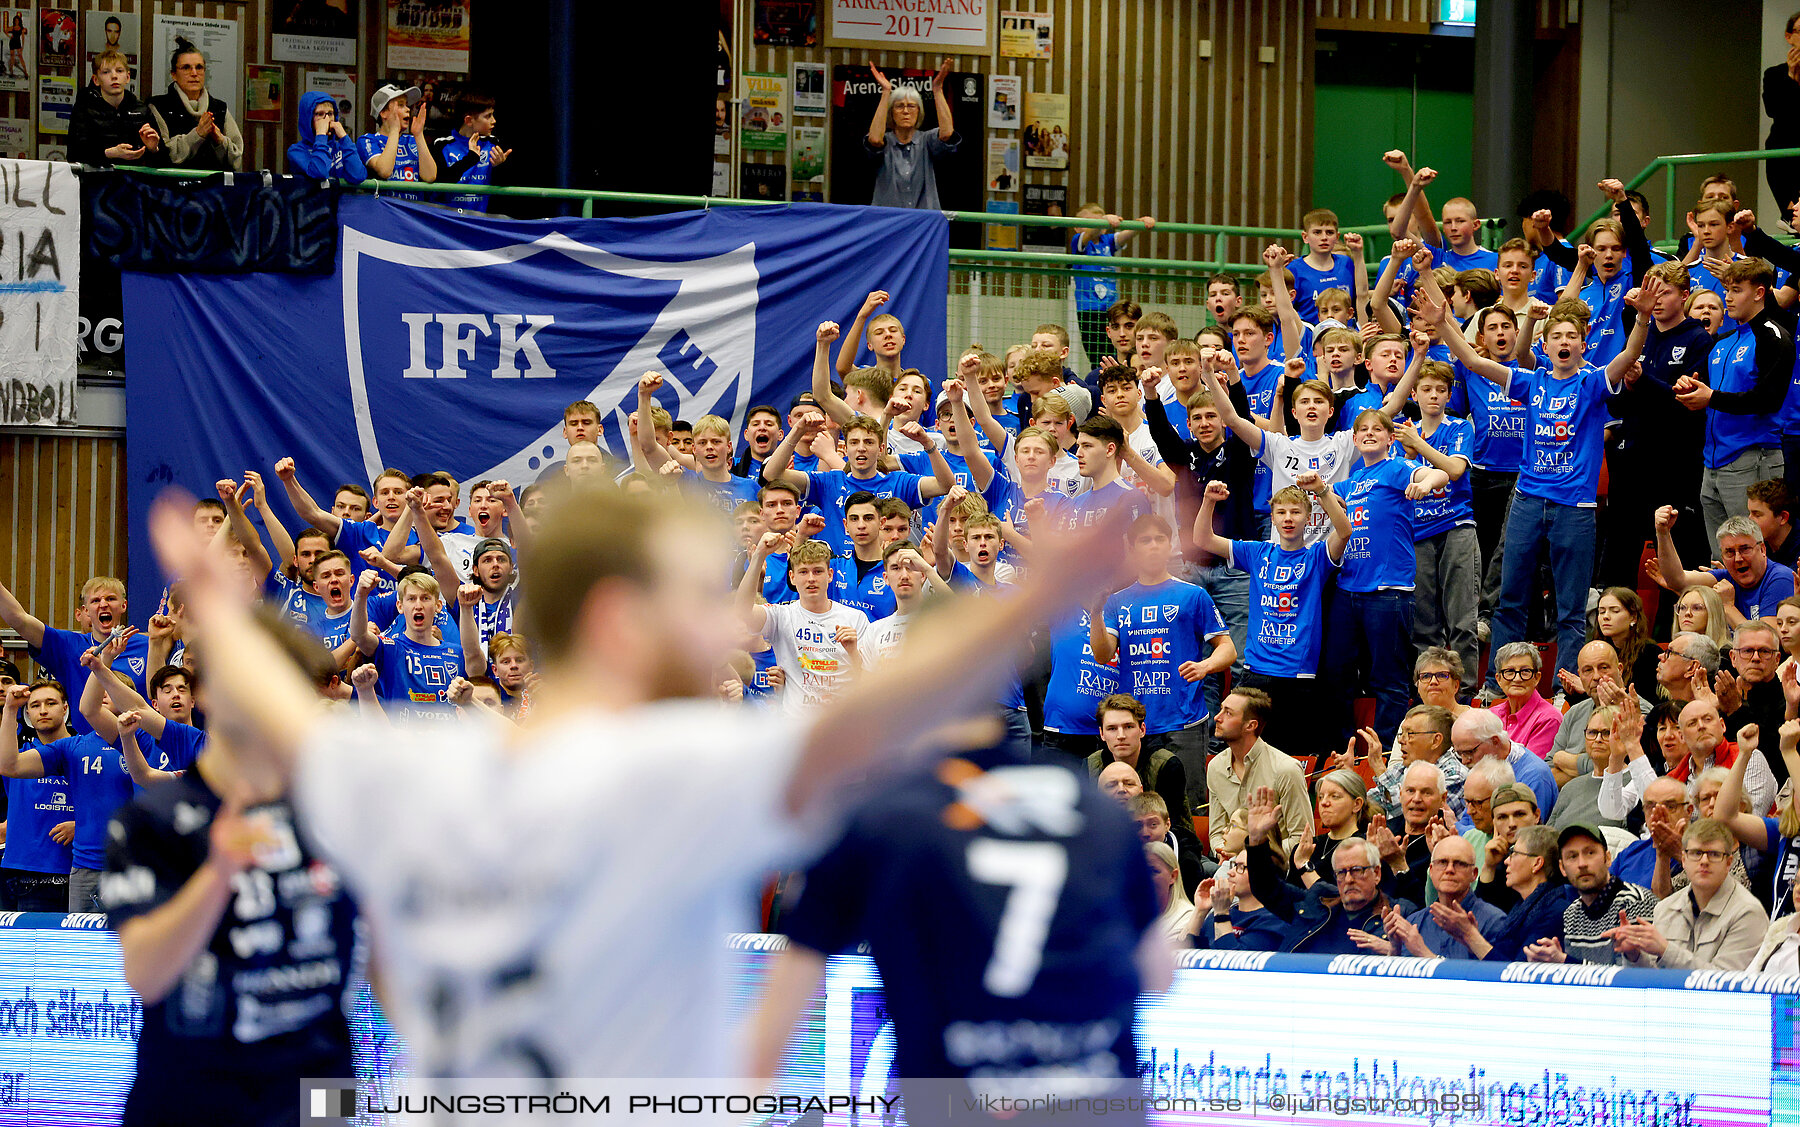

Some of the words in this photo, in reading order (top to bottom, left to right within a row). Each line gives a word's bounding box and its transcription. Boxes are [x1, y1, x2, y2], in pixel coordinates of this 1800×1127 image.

[885, 14, 934, 38] 2017
[746, 78, 782, 92] Villa
[843, 80, 882, 95] Arena
[889, 76, 934, 92] Skövd
[389, 171, 418, 182] ALOC
[401, 312, 557, 379] IFK
[1534, 422, 1576, 440] DALOC
[1284, 456, 1299, 470] 72
[1534, 450, 1573, 466] RAPP
[1534, 465, 1574, 473] FASTIGHETER
[1348, 506, 1370, 526] LOC
[1345, 537, 1370, 554] APP
[1260, 593, 1298, 612] DALOC
[1118, 614, 1132, 628] 54
[1259, 619, 1297, 637] RAPP
[796, 628, 811, 641] 45
[1133, 628, 1170, 636] INTERSPORT
[1258, 636, 1296, 644] FASTIGHETER
[323, 635, 338, 649] 57
[1129, 638, 1171, 658] DALOC
[406, 655, 422, 675] 15
[1078, 669, 1120, 694] RAPP
[1132, 671, 1171, 688] RAPP
[1134, 688, 1171, 696] FSTIGHETER
[82, 756, 103, 774] 14
[159, 752, 169, 770] 9
[34, 803, 75, 812] LOGISTIC
[965, 838, 1068, 998] 7
